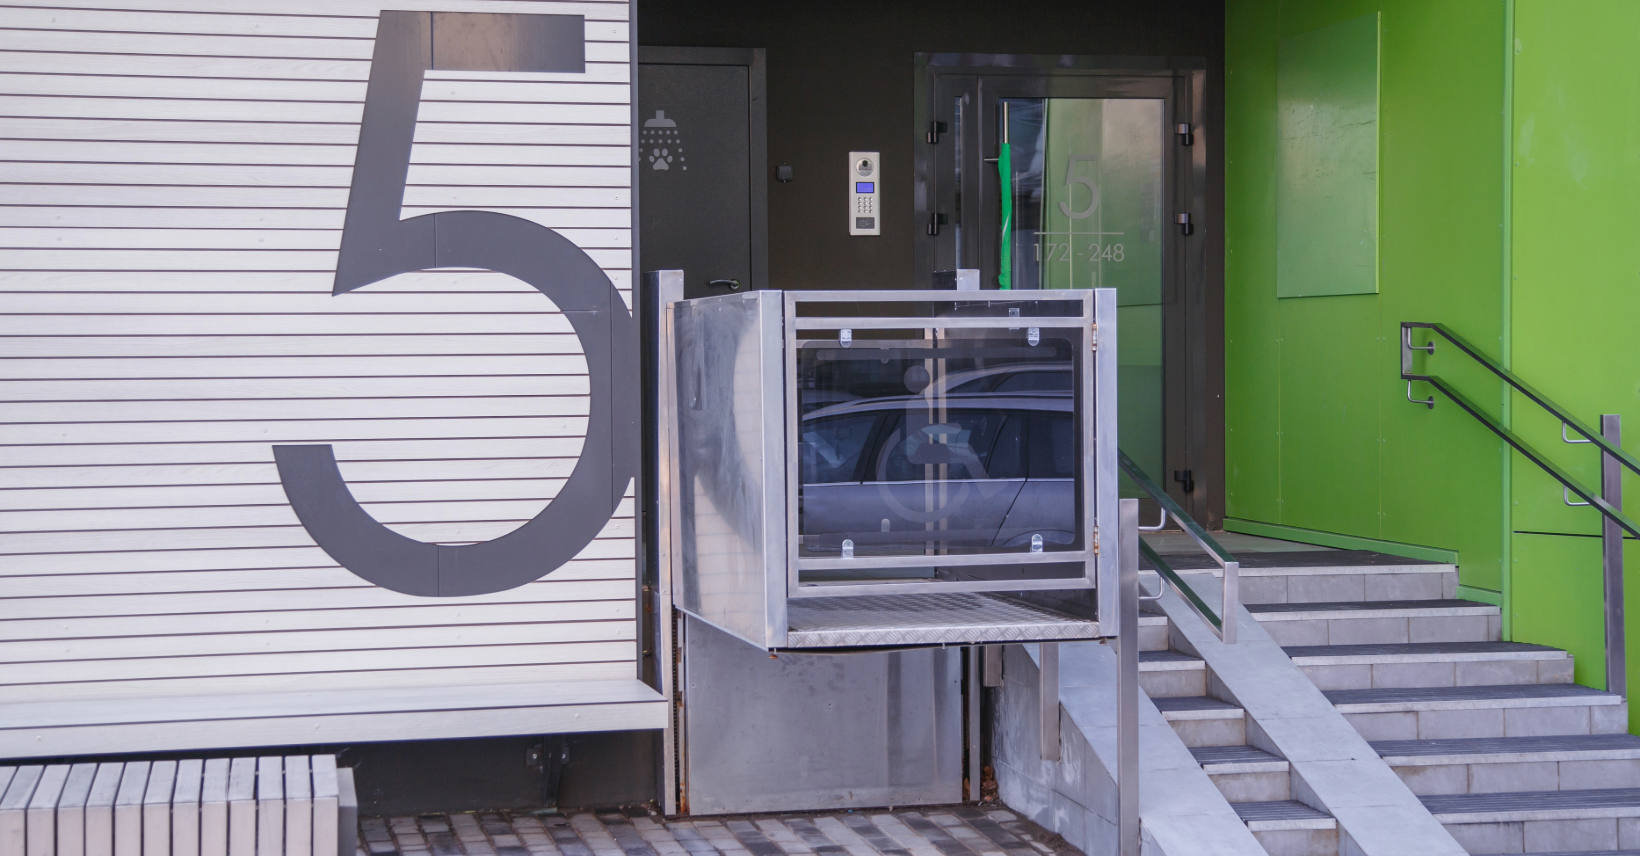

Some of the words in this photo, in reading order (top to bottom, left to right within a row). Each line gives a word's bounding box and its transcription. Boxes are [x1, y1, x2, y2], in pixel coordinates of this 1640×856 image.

[1059, 154, 1099, 220] 5
[1033, 243, 1070, 262] 172
[1088, 243, 1125, 262] 248
[272, 10, 639, 597] 5
